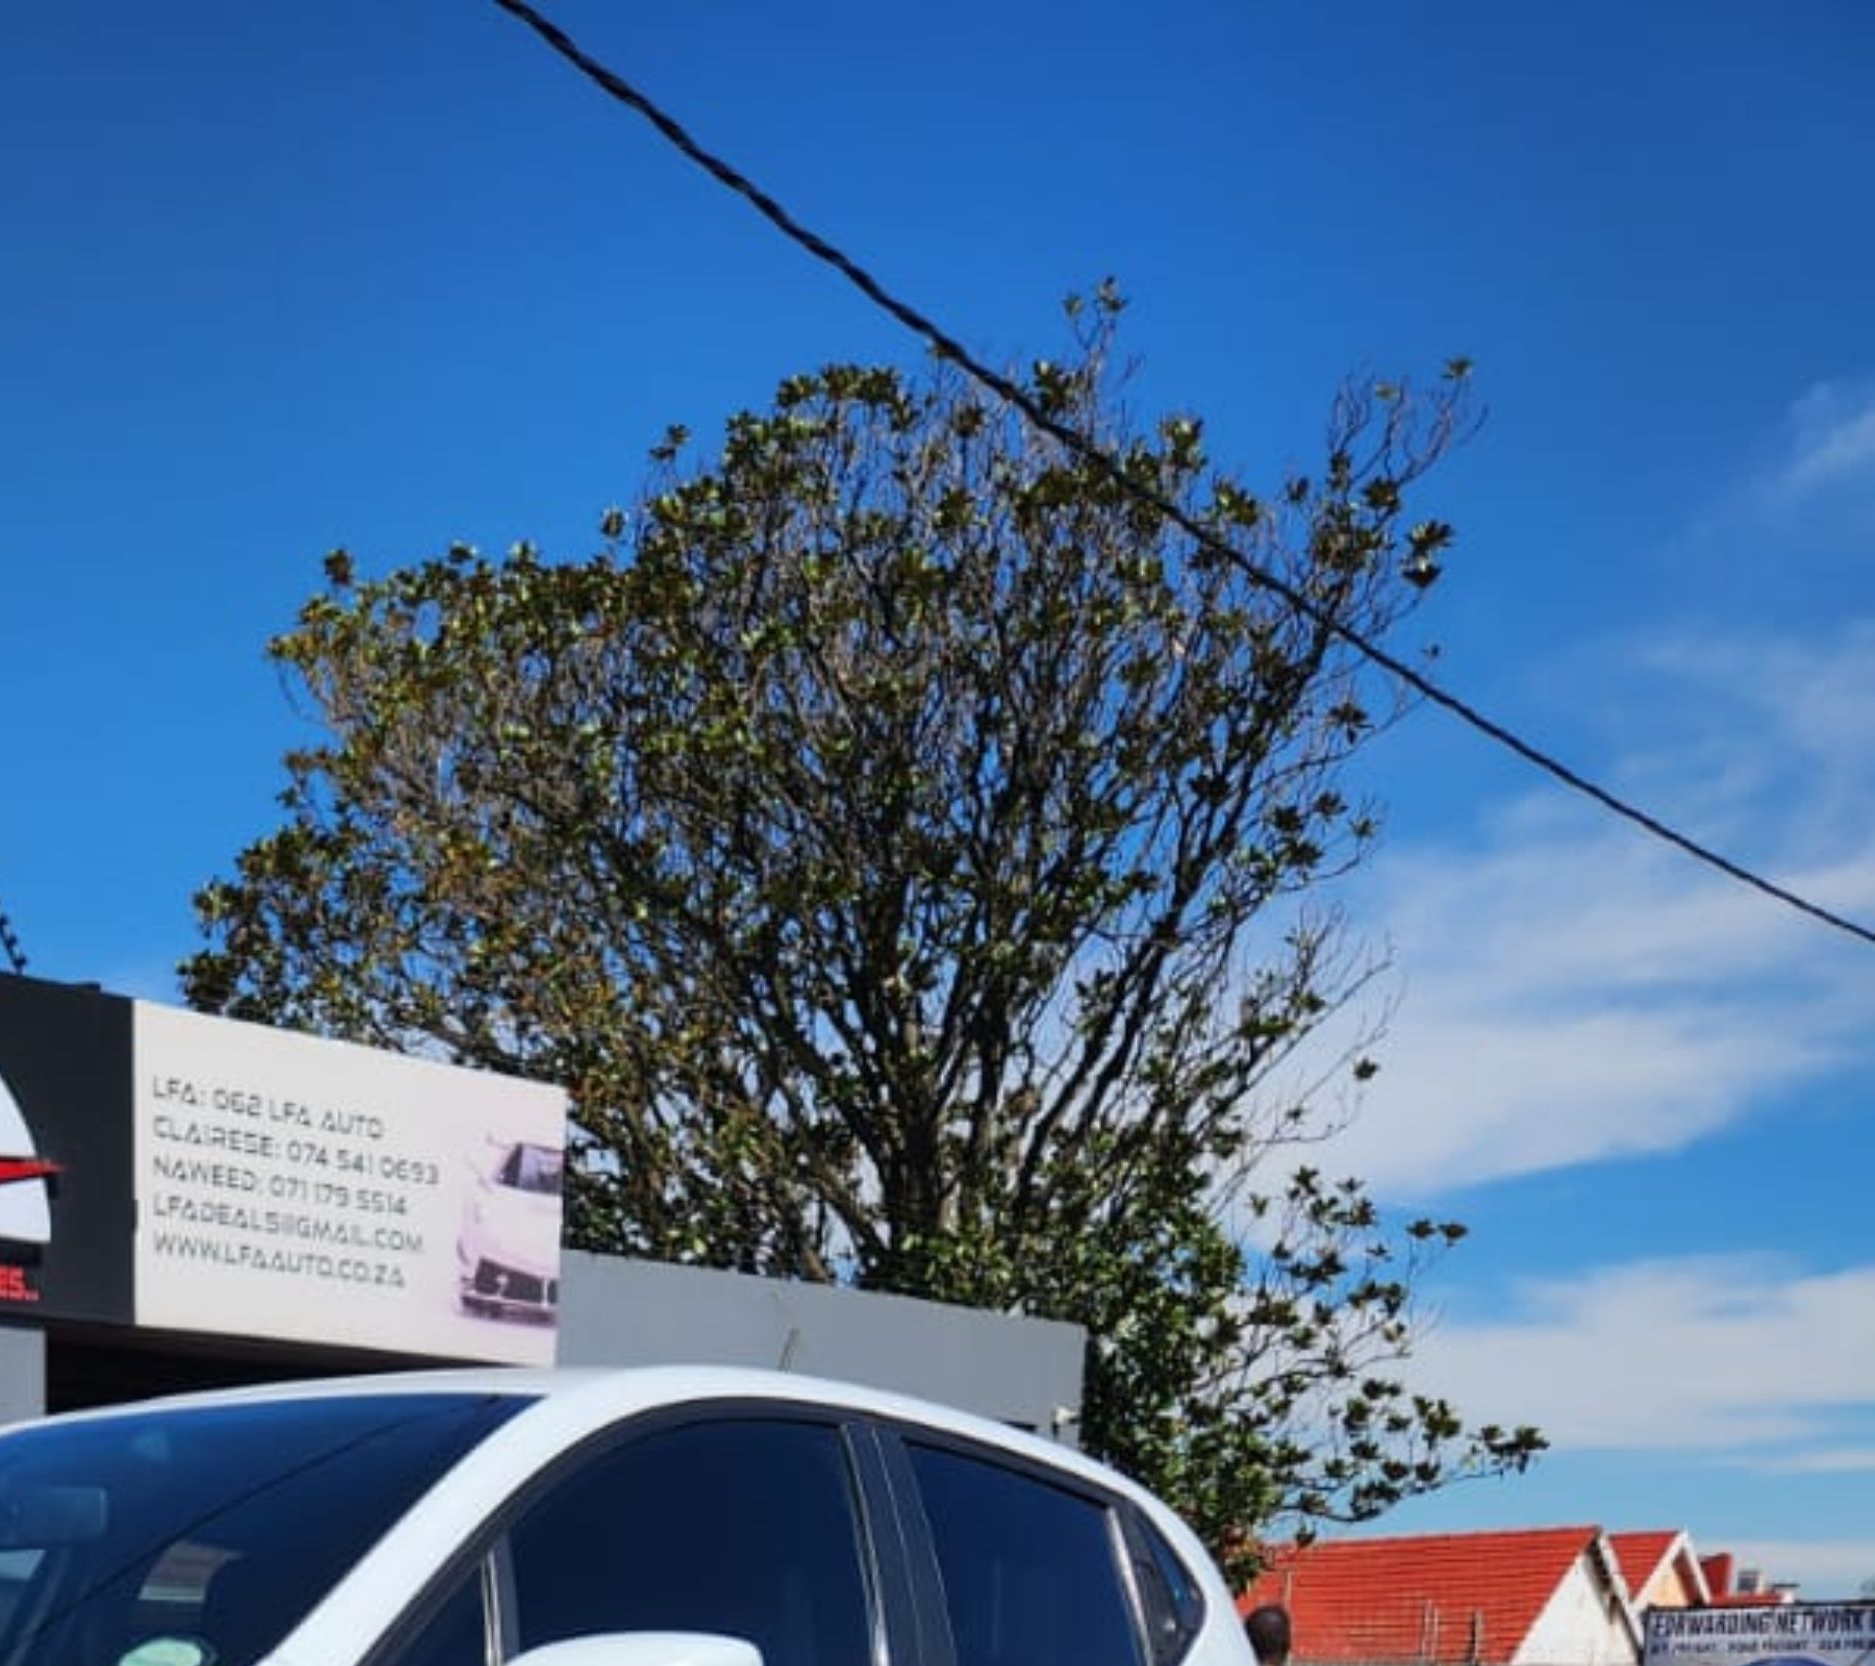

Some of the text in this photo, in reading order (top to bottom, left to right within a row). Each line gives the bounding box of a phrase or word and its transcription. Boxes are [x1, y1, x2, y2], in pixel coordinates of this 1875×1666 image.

[269, 1098, 311, 1128] LFA
[321, 1109, 385, 1140] AUTO
[287, 1138, 328, 1166] 074
